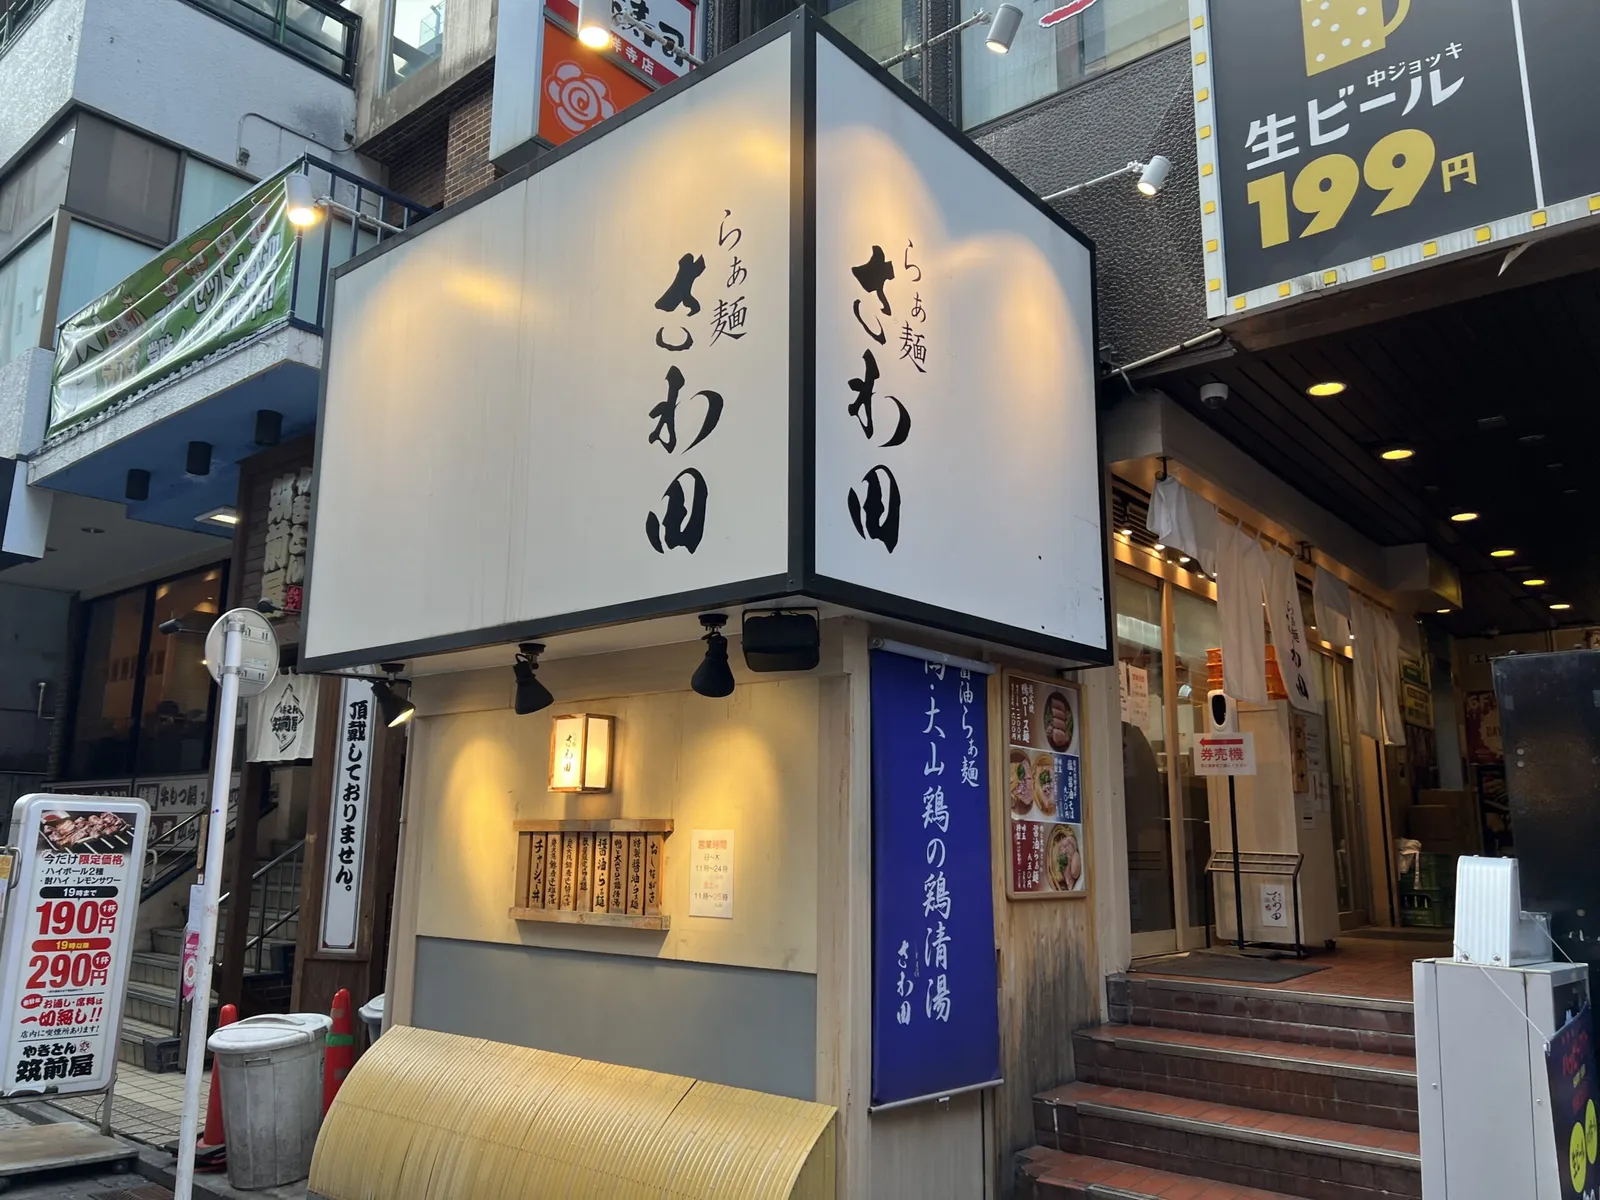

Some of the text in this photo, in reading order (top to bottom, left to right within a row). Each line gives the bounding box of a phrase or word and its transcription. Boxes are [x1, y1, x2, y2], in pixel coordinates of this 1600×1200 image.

[1367, 42, 1464, 89] 中ジョッキ
[1245, 69, 1466, 171] 生ビール
[1246, 128, 1478, 249] 199円
[709, 208, 748, 347] らぁ麺
[899, 238, 927, 374] らぁ麺
[645, 252, 724, 555] さわ田
[847, 244, 912, 555] さわ田
[1200, 747, 1244, 761] 券売機
[335, 699, 368, 892] 頂戴しておりません。
[43, 853, 123, 865] 今だけ限定価格
[531, 838, 544, 903] チャーシュー丼
[595, 837, 609, 908] 醤油らぁ麺
[629, 837, 642, 910] 特製醤油らぁ麺
[648, 840, 659, 904] おしながき
[698, 839, 727, 850] 営業時間
[36, 900, 116, 935] 190円
[63, 887, 98, 897] 19時まで
[25, 952, 108, 989] 290円
[55, 940, 90, 950] 19時以降
[896, 939, 914, 1026] さわ田
[20, 1026, 100, 1039] 店内に喫煙所あります!
[23, 1042, 76, 1058] やきとん
[15, 1053, 94, 1083] 筑前屋
